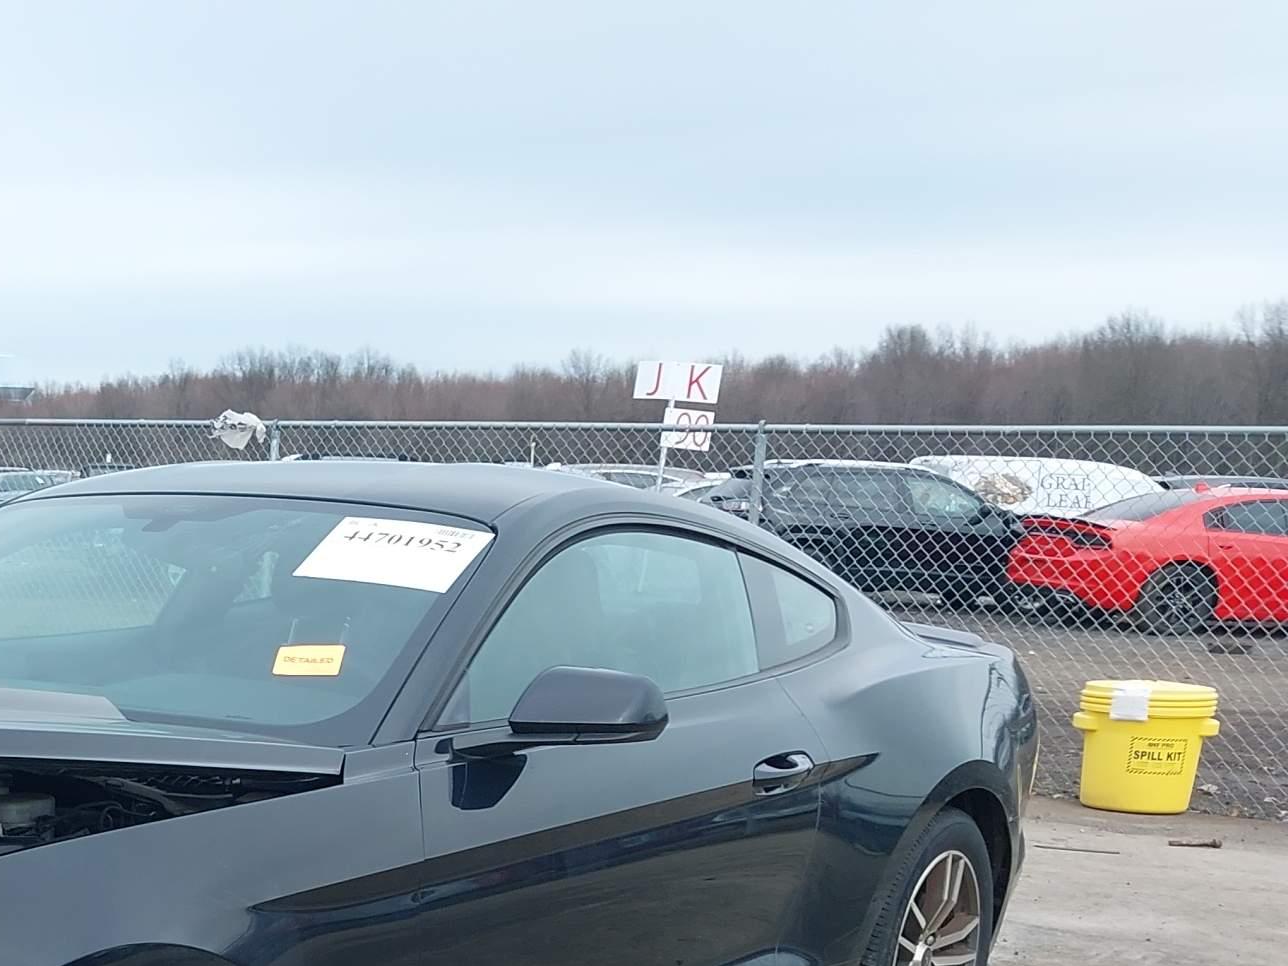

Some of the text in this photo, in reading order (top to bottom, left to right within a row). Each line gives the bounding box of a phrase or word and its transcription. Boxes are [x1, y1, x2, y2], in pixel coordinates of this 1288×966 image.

[646, 362, 712, 400] J K
[344, 530, 462, 553] 44701952
[1133, 750, 1183, 761] SPILL KIT
